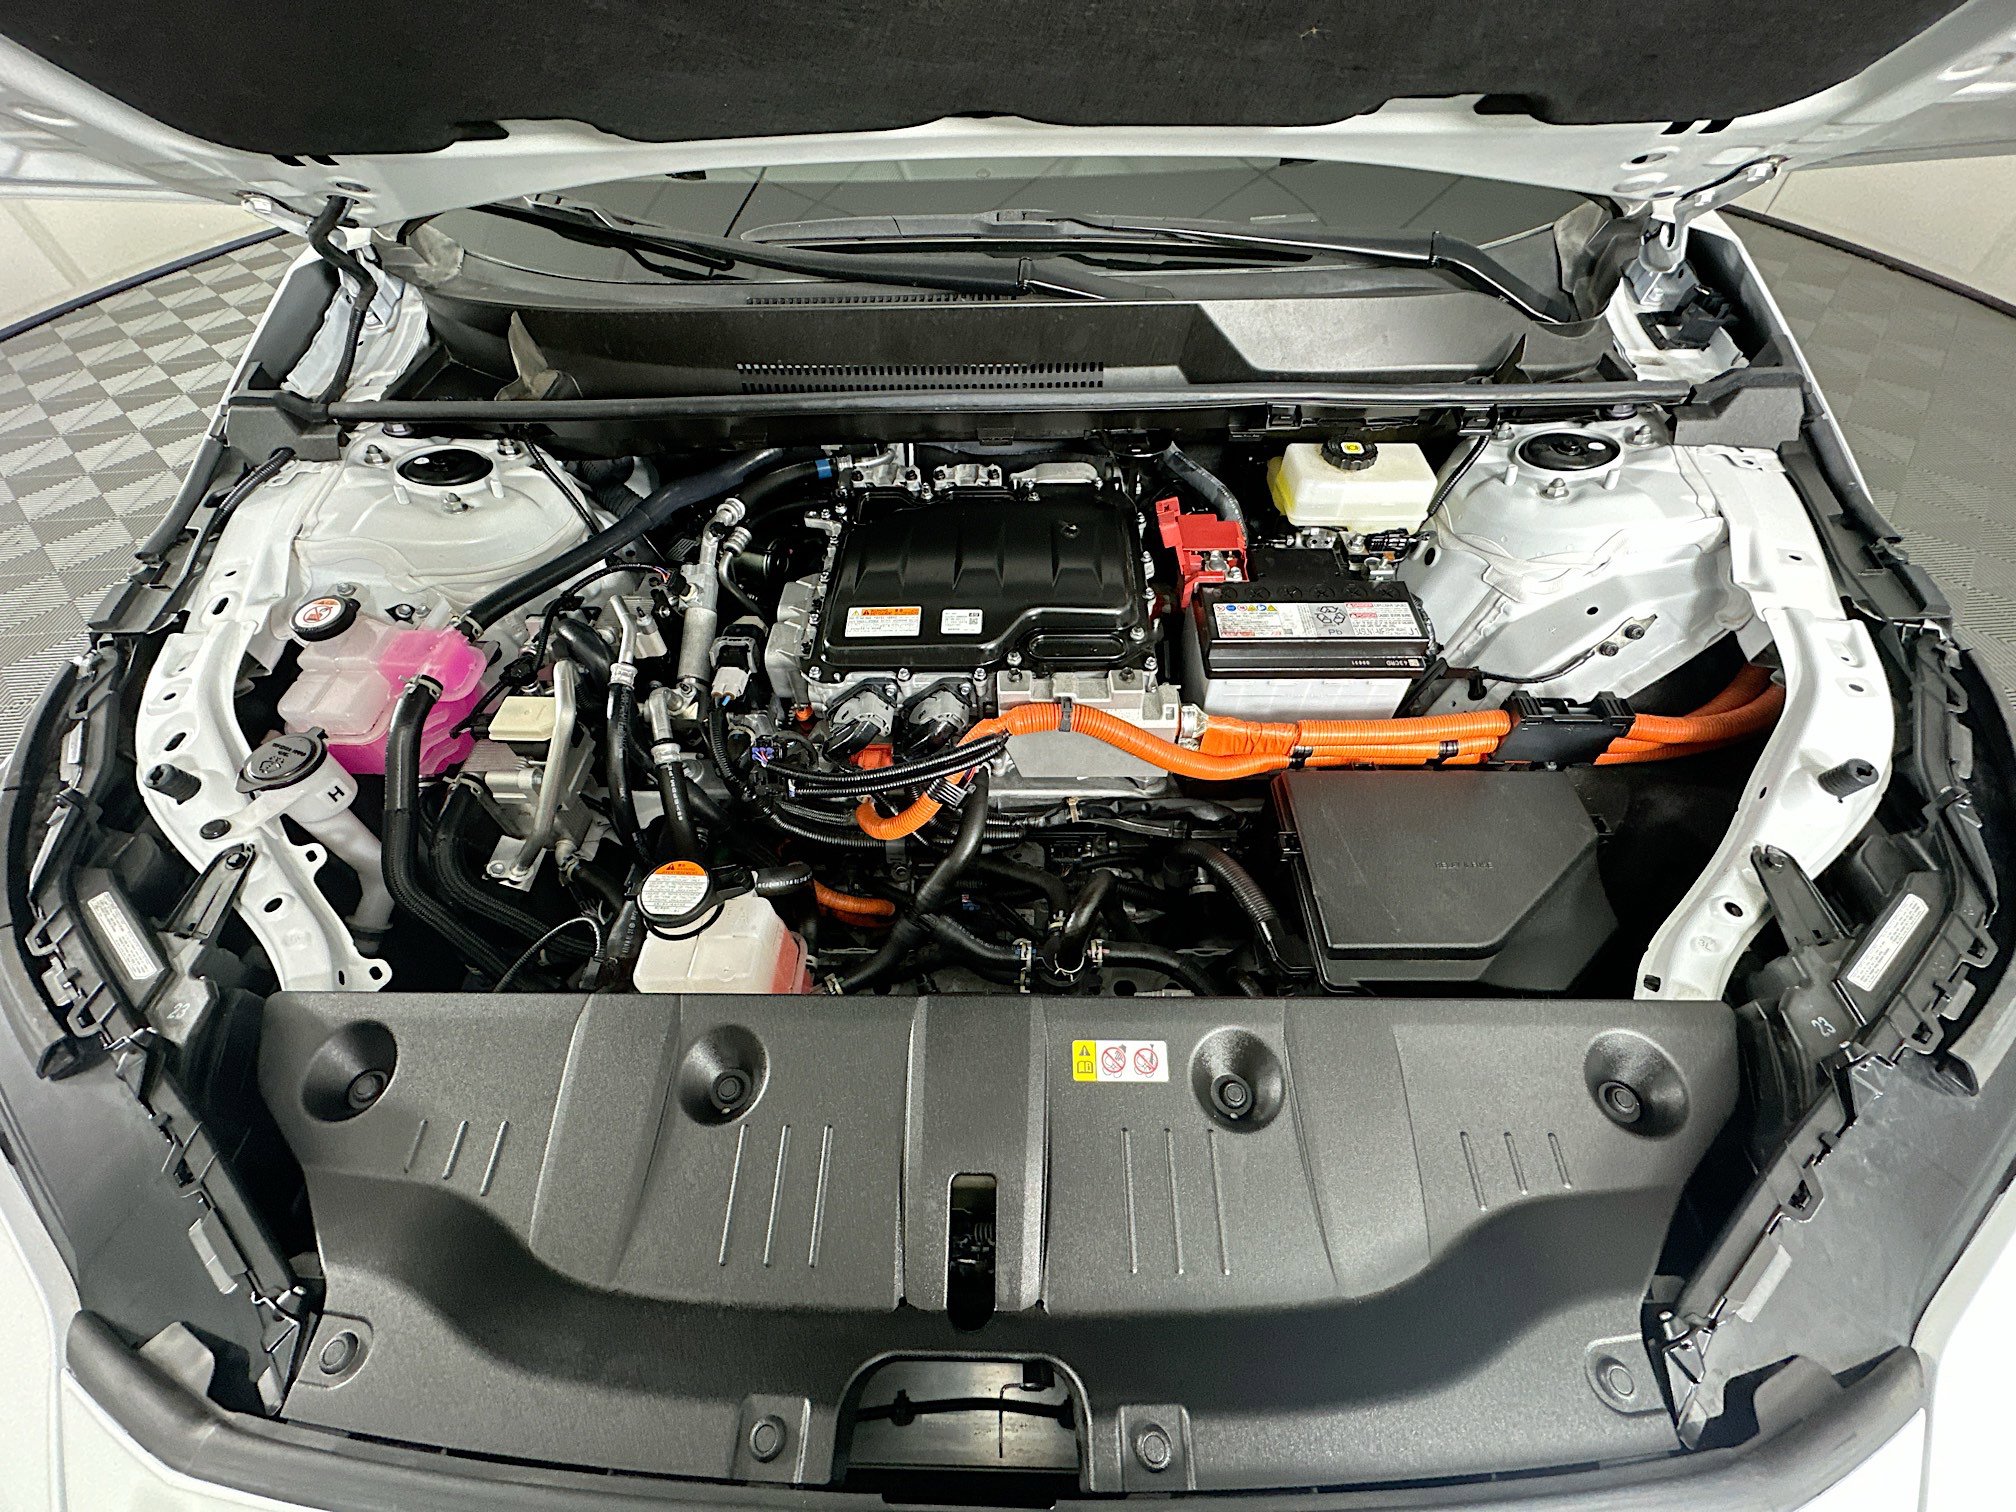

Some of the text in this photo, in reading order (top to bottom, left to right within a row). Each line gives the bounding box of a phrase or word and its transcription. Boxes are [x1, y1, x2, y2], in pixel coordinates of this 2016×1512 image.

[327, 785, 345, 802] H
[166, 1002, 191, 1020] 23
[1811, 1016, 1837, 1037] 23
